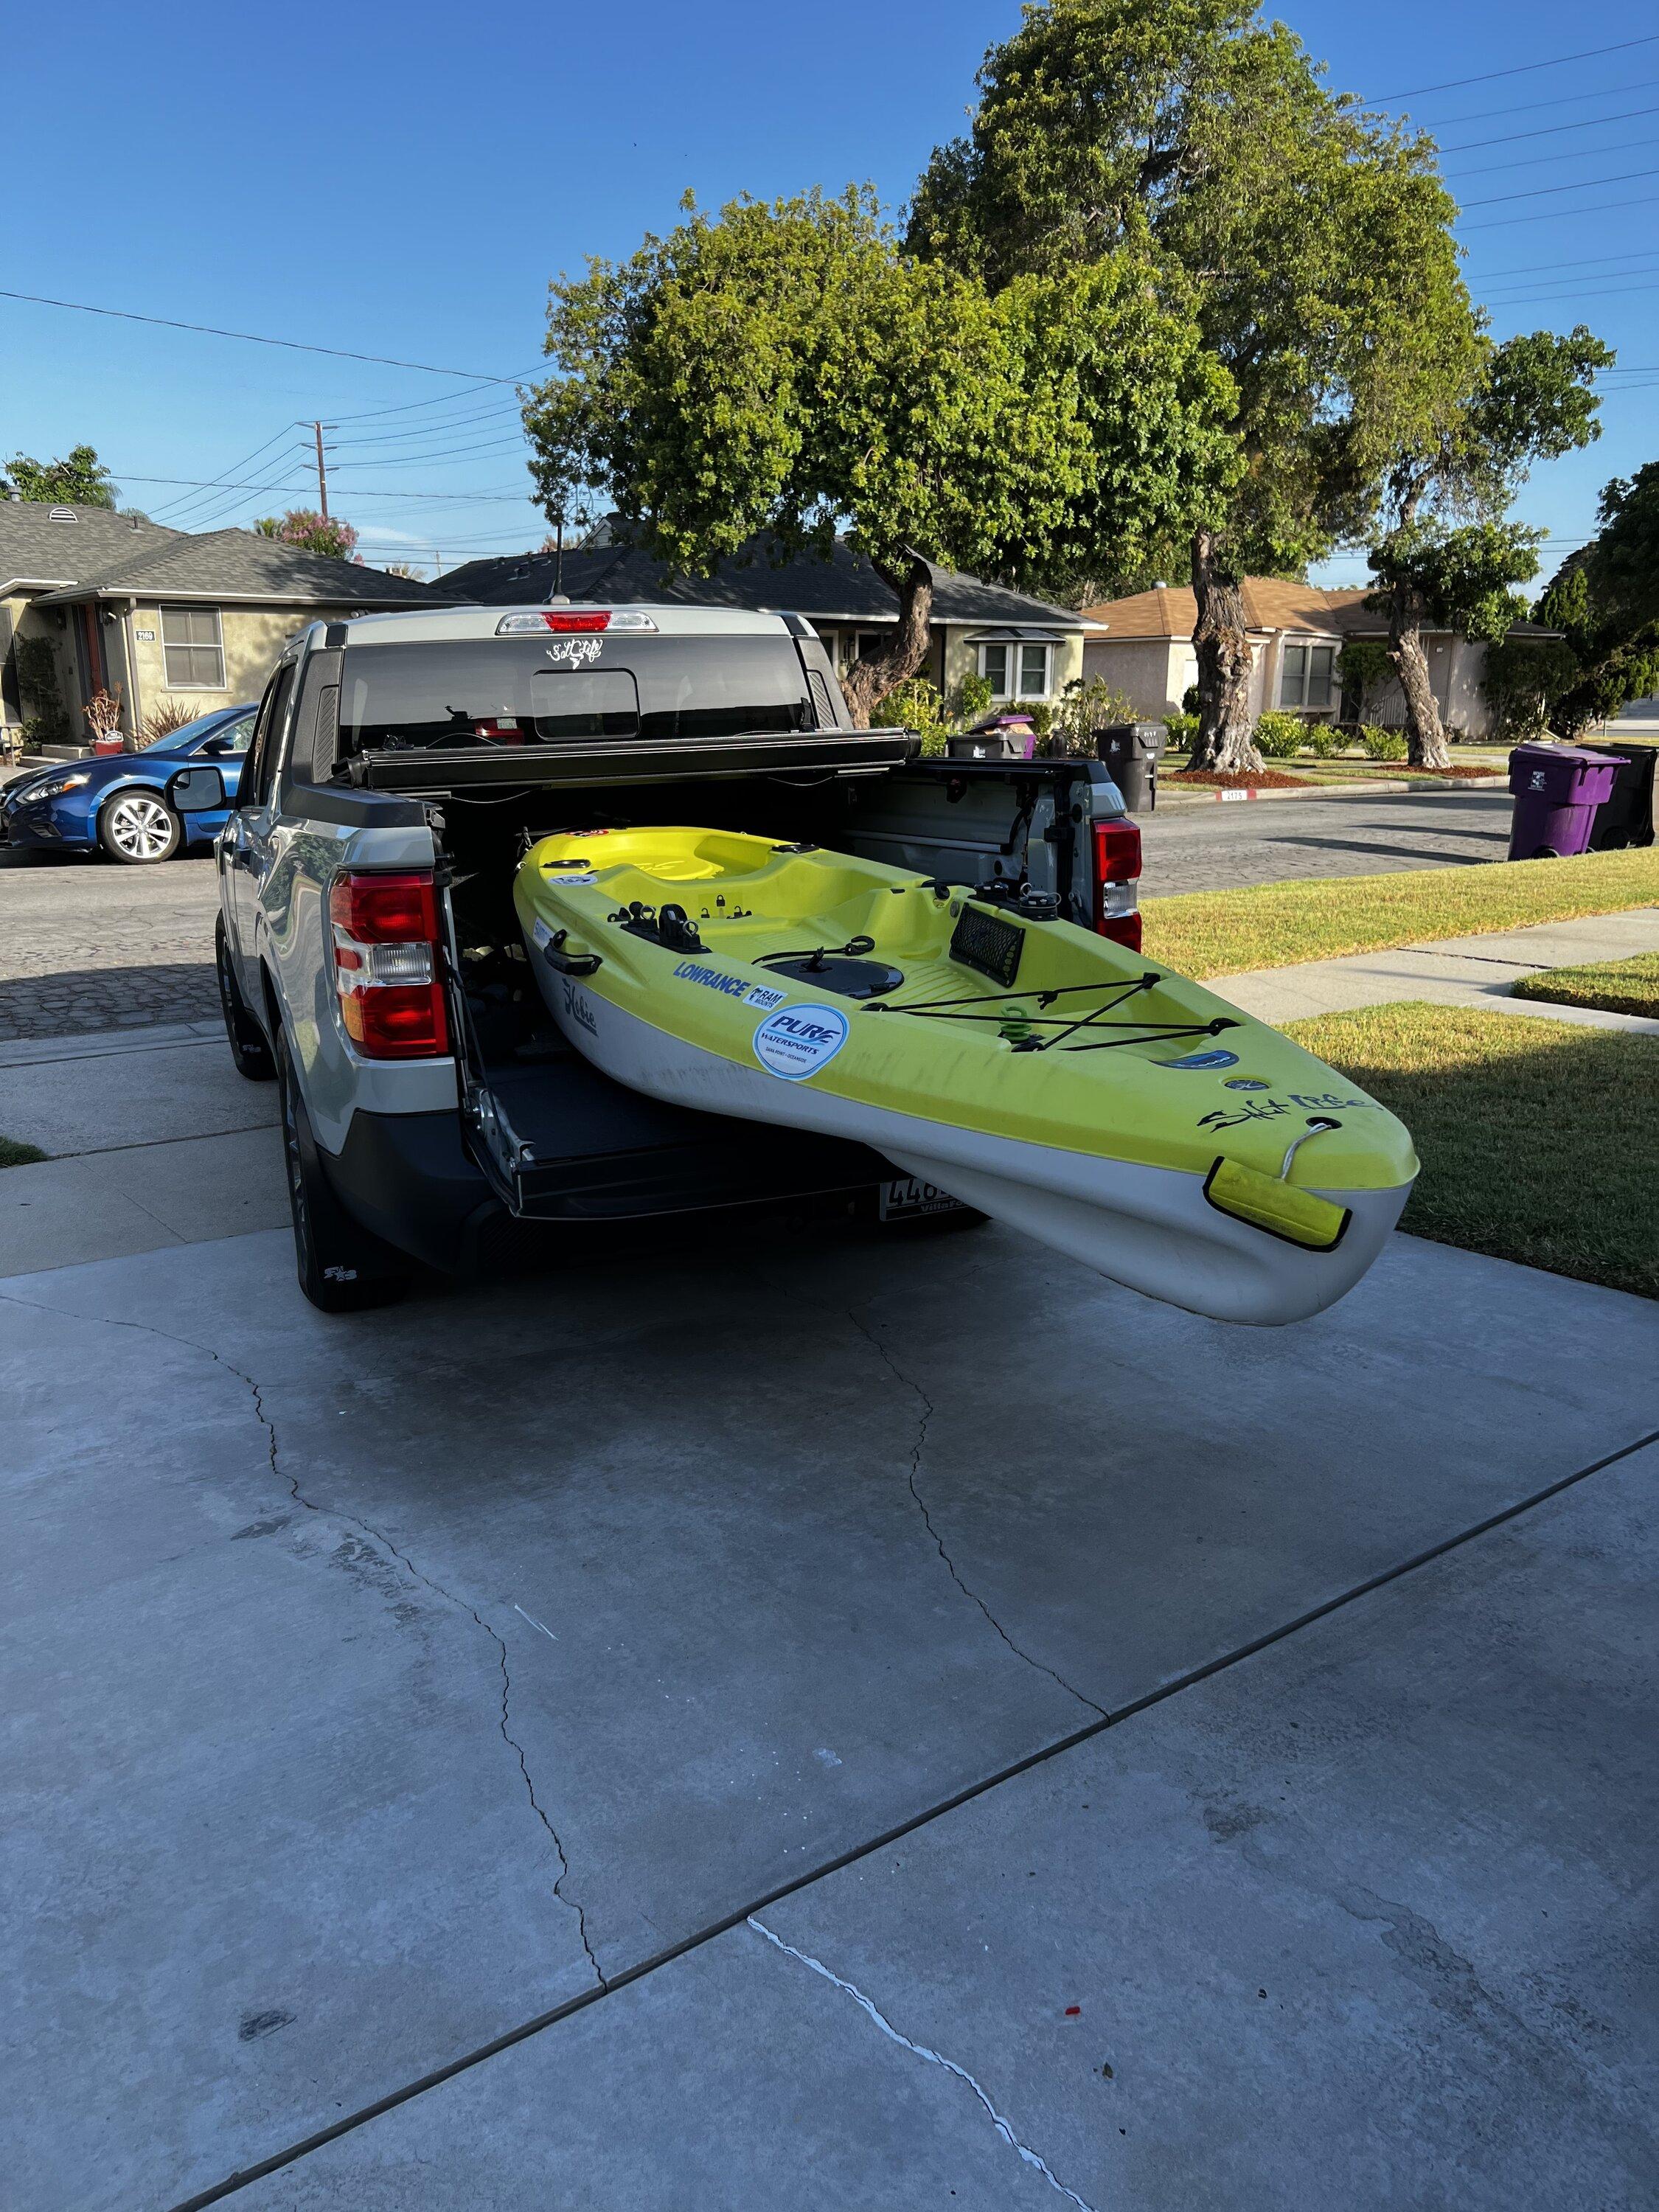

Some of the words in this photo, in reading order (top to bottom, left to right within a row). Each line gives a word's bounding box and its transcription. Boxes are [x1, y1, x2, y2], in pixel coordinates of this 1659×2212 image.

[546, 639, 585, 661] Salt
[579, 639, 603, 663] Life
[1227, 791, 1242, 799] 2175
[672, 961, 751, 997] LOWRANCE
[562, 978, 599, 1038] Hobie
[754, 998, 775, 1009] MOUNTS
[759, 990, 784, 1004] RAM
[771, 1015, 841, 1044] PURE
[761, 1032, 819, 1055] WATERSPORTS
[787, 1053, 807, 1063] OCEANSIDE
[1196, 1099, 1291, 1133] Salt
[1287, 1093, 1377, 1110] Life
[888, 1178, 948, 1206] 446
